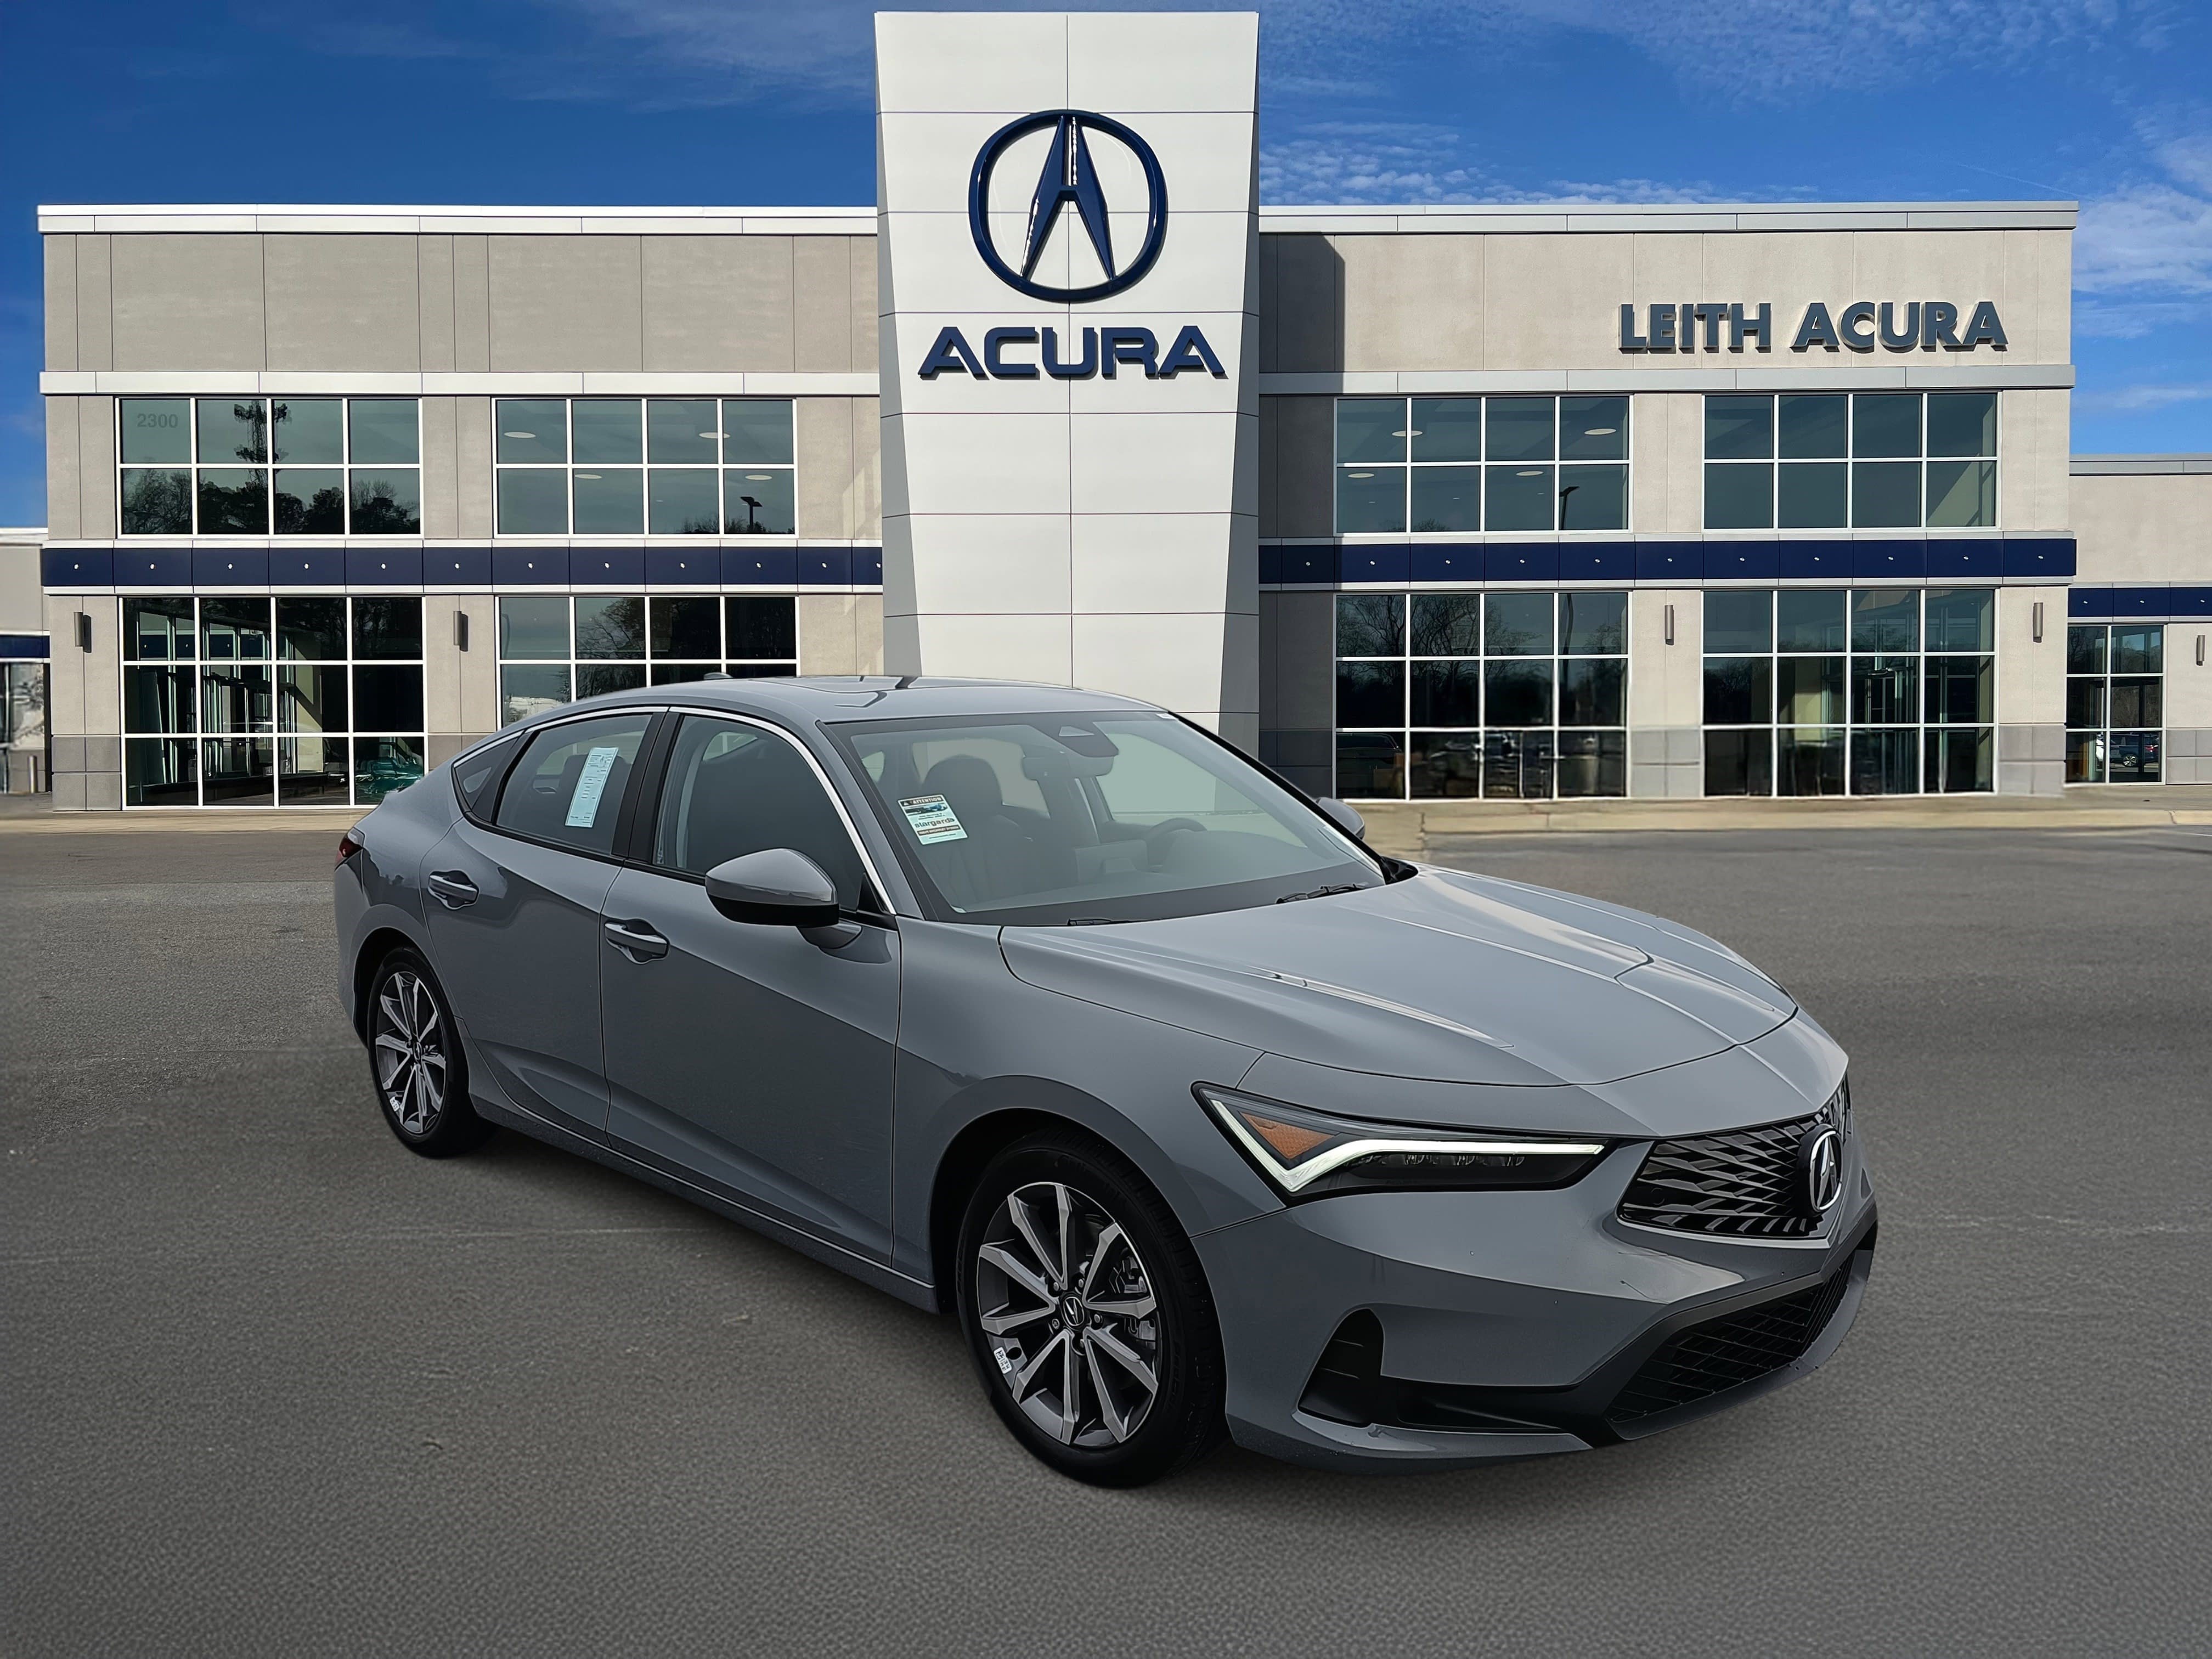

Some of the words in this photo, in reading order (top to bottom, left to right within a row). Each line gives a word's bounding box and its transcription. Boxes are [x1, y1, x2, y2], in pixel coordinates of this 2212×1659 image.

[918, 326, 1228, 380] ACURA
[1618, 303, 1771, 353] LEITH
[1790, 301, 2008, 353] ACURA
[137, 413, 178, 428] 2300
